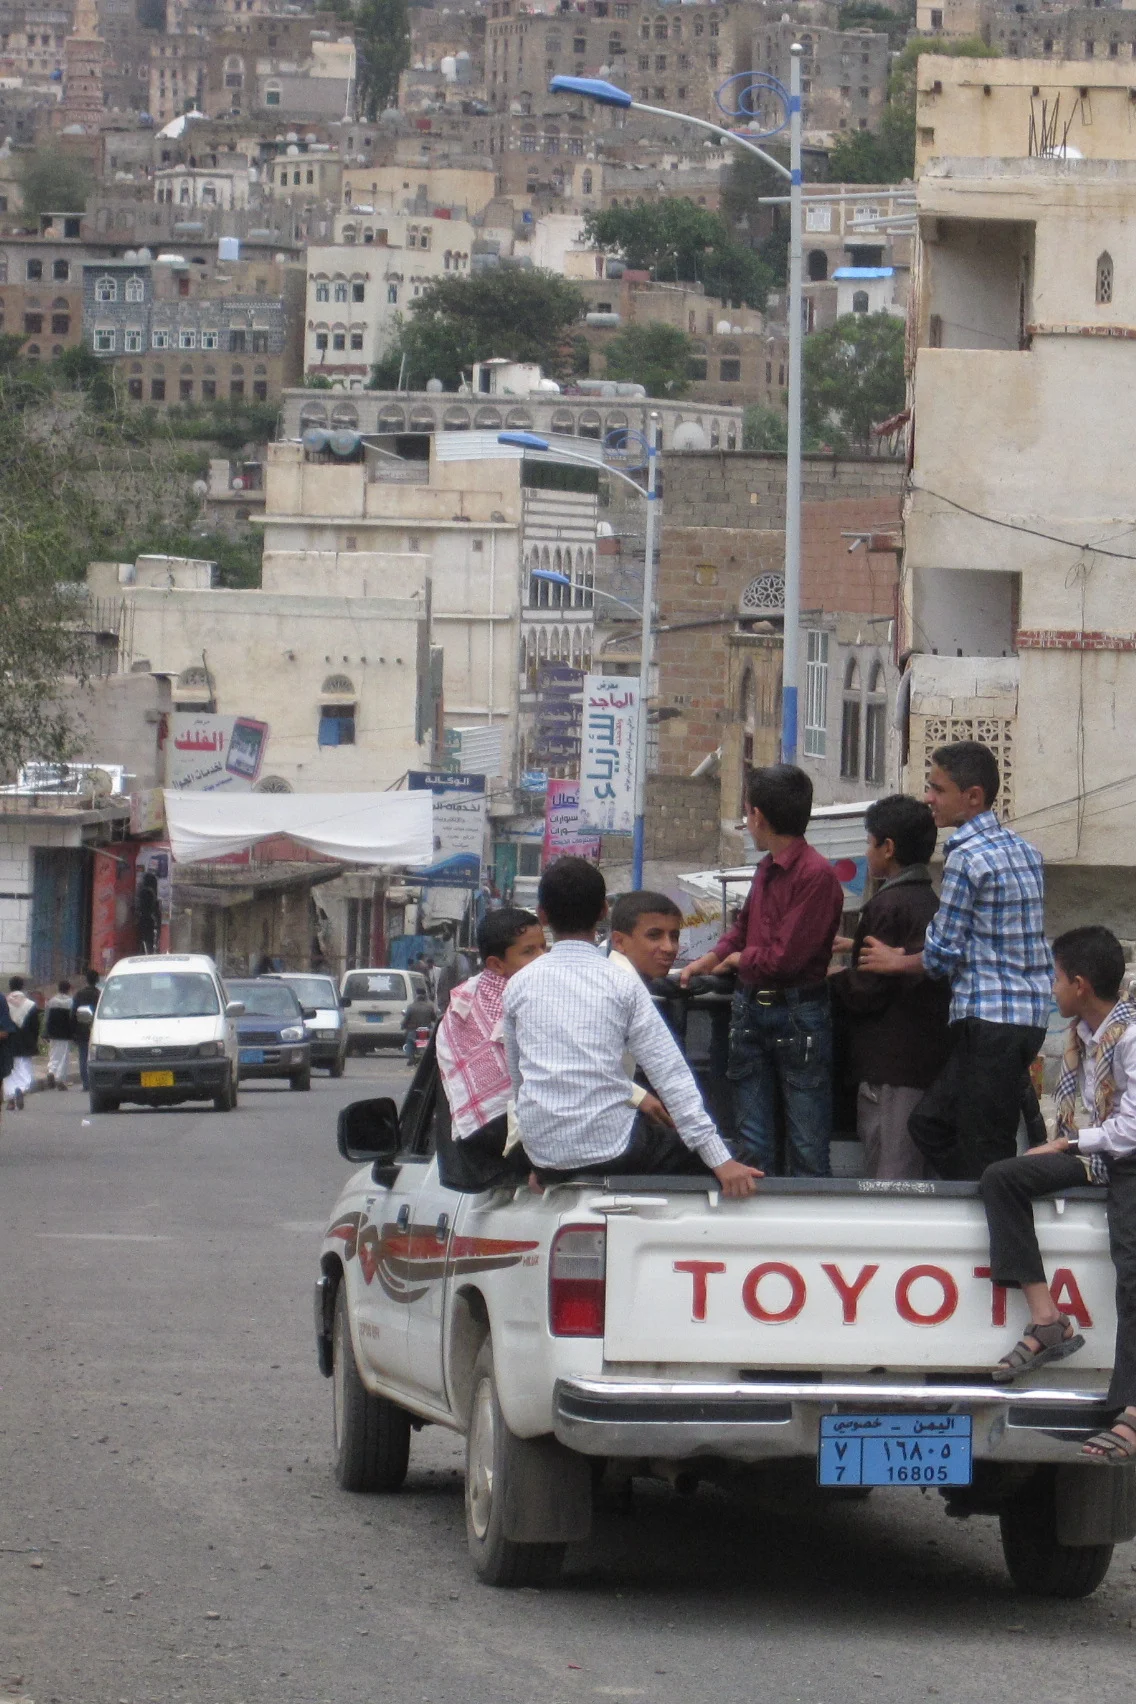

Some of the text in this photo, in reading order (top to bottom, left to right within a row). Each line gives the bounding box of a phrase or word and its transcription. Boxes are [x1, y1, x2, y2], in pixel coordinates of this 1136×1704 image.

[596, 680, 620, 690] معرض
[588, 692, 634, 711] الماجد
[174, 729, 223, 751] الفلك
[195, 761, 222, 780] لخدمات
[424, 775, 470, 787] الوكالة
[671, 1259, 1095, 1330] TOYOTA
[833, 1417, 883, 1434] خصوصي
[913, 1416, 956, 1434] اليمن
[834, 1440, 952, 1462] ٧ ١٦٨٠٥
[835, 1466, 949, 1482] 7 16805
